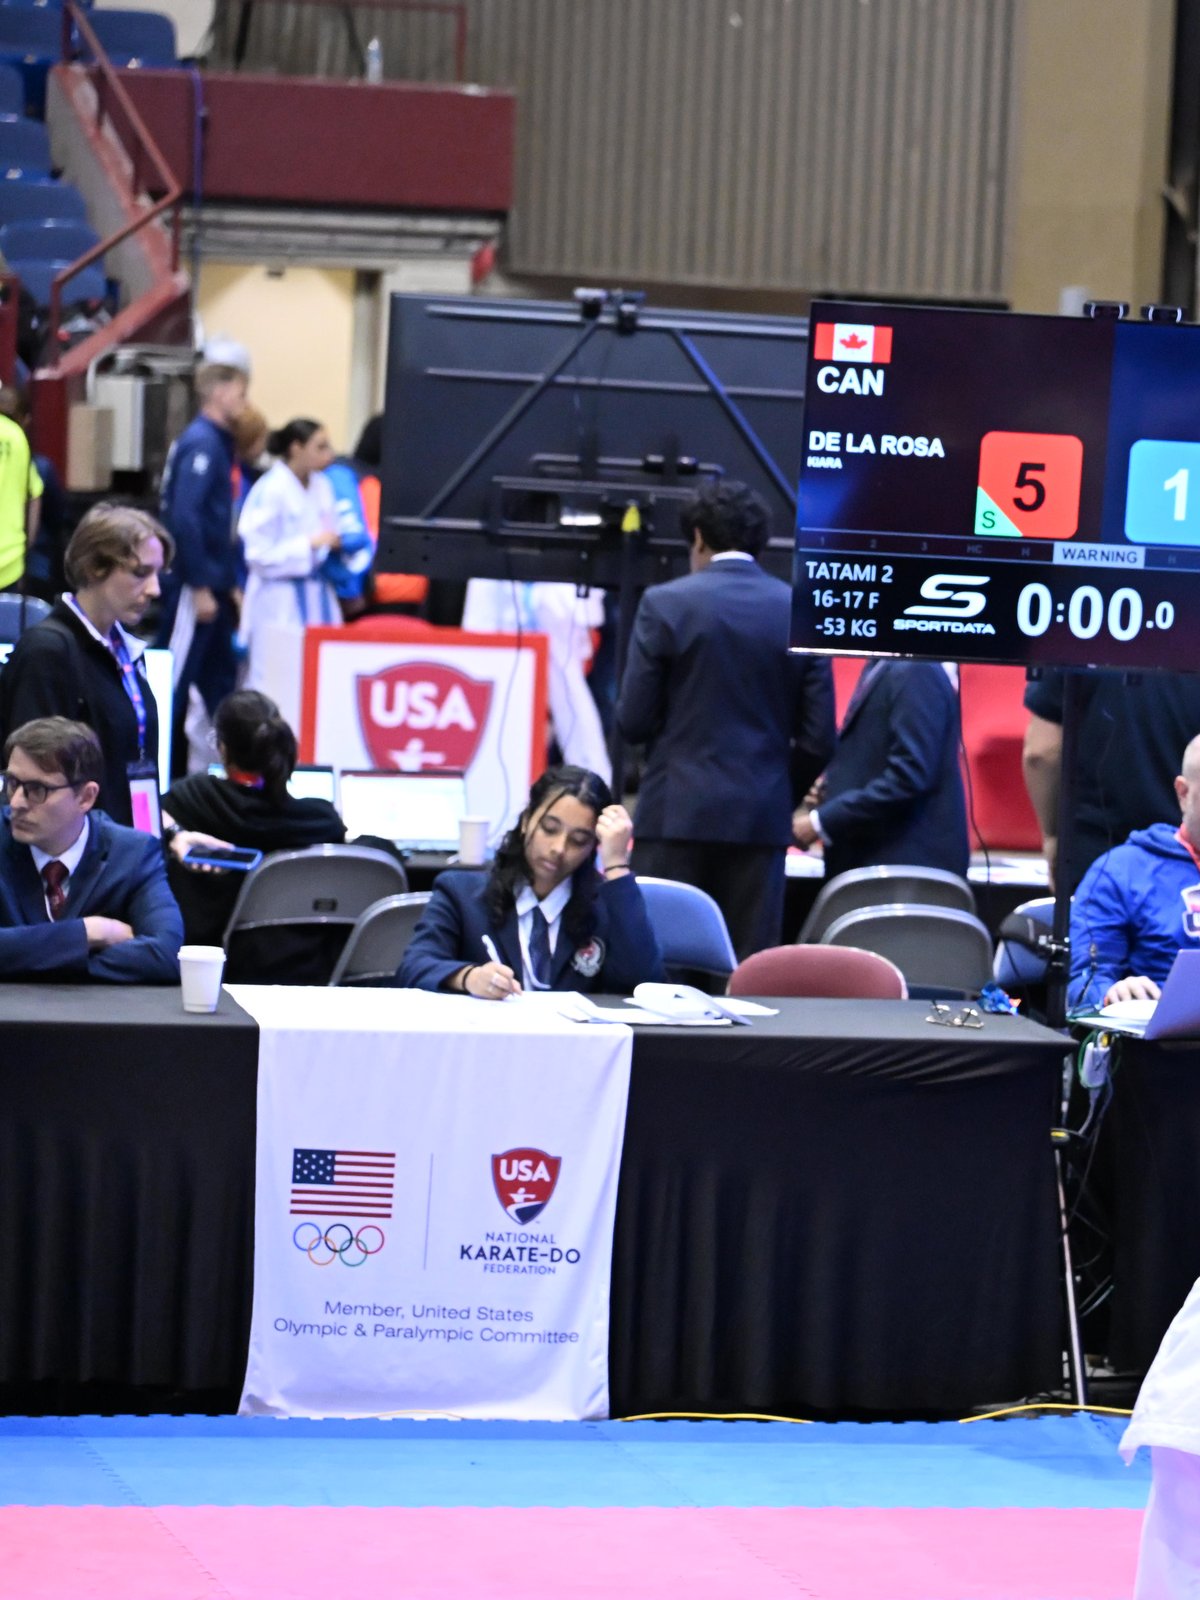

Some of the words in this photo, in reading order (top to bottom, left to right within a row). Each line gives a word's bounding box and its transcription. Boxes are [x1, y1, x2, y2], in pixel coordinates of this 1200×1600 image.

[817, 366, 885, 396] CAN
[809, 430, 841, 452] DE
[845, 433, 876, 454] LA
[881, 434, 945, 458] ROSA
[807, 456, 843, 469] KIARA
[1013, 462, 1046, 512] 5
[1163, 468, 1189, 521] 1
[982, 511, 996, 529] S
[1063, 548, 1137, 564] WARNING
[805, 561, 877, 582] TATAMI
[881, 565, 893, 583] 2
[812, 589, 864, 609] 16-17
[869, 592, 880, 609] F
[815, 617, 845, 636] -53
[851, 619, 877, 637] KG
[893, 618, 996, 635] SPORTDATA
[370, 679, 477, 732] USA
[500, 1159, 551, 1182] USA
[485, 1231, 556, 1245] NATIONAL
[460, 1244, 580, 1264] KARATE-DO
[484, 1263, 556, 1275] FEDERATION
[324, 1301, 405, 1319] Member,
[412, 1304, 471, 1320] United
[477, 1306, 534, 1322] States
[273, 1317, 348, 1338] Olympic
[354, 1323, 367, 1337] &
[373, 1323, 473, 1343] Paralympic
[480, 1326, 579, 1344] Committee
